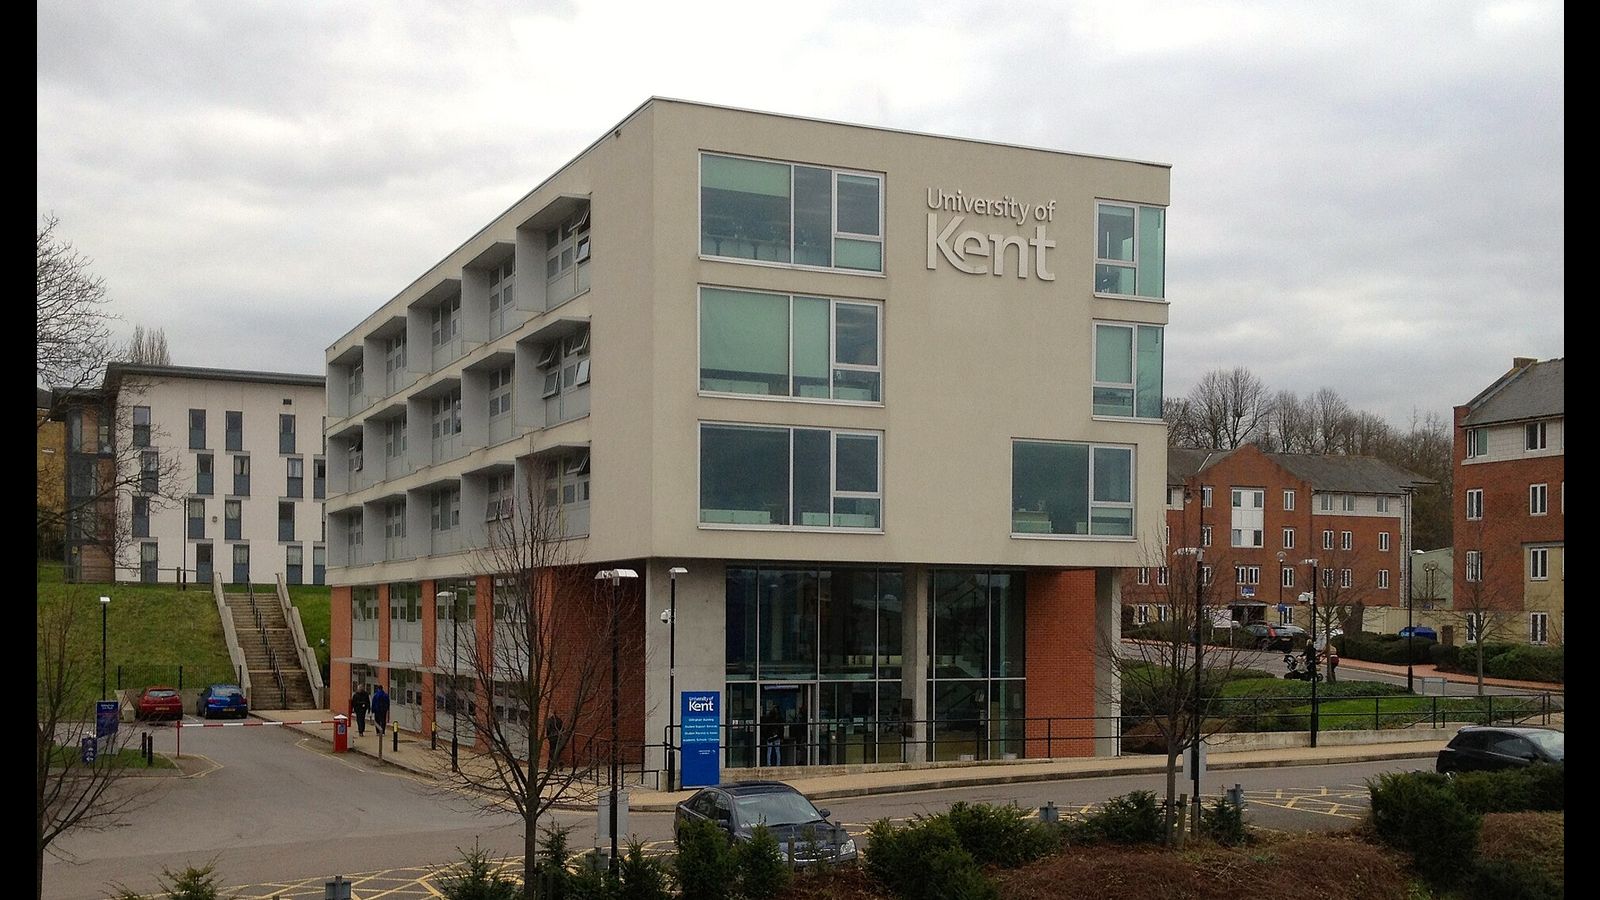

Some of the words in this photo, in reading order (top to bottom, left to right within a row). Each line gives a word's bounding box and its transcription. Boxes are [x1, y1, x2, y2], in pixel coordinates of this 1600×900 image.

[927, 187, 1030, 225] University
[1034, 200, 1057, 222] of
[926, 212, 1057, 281] Kent
[688, 700, 714, 712] Kent
